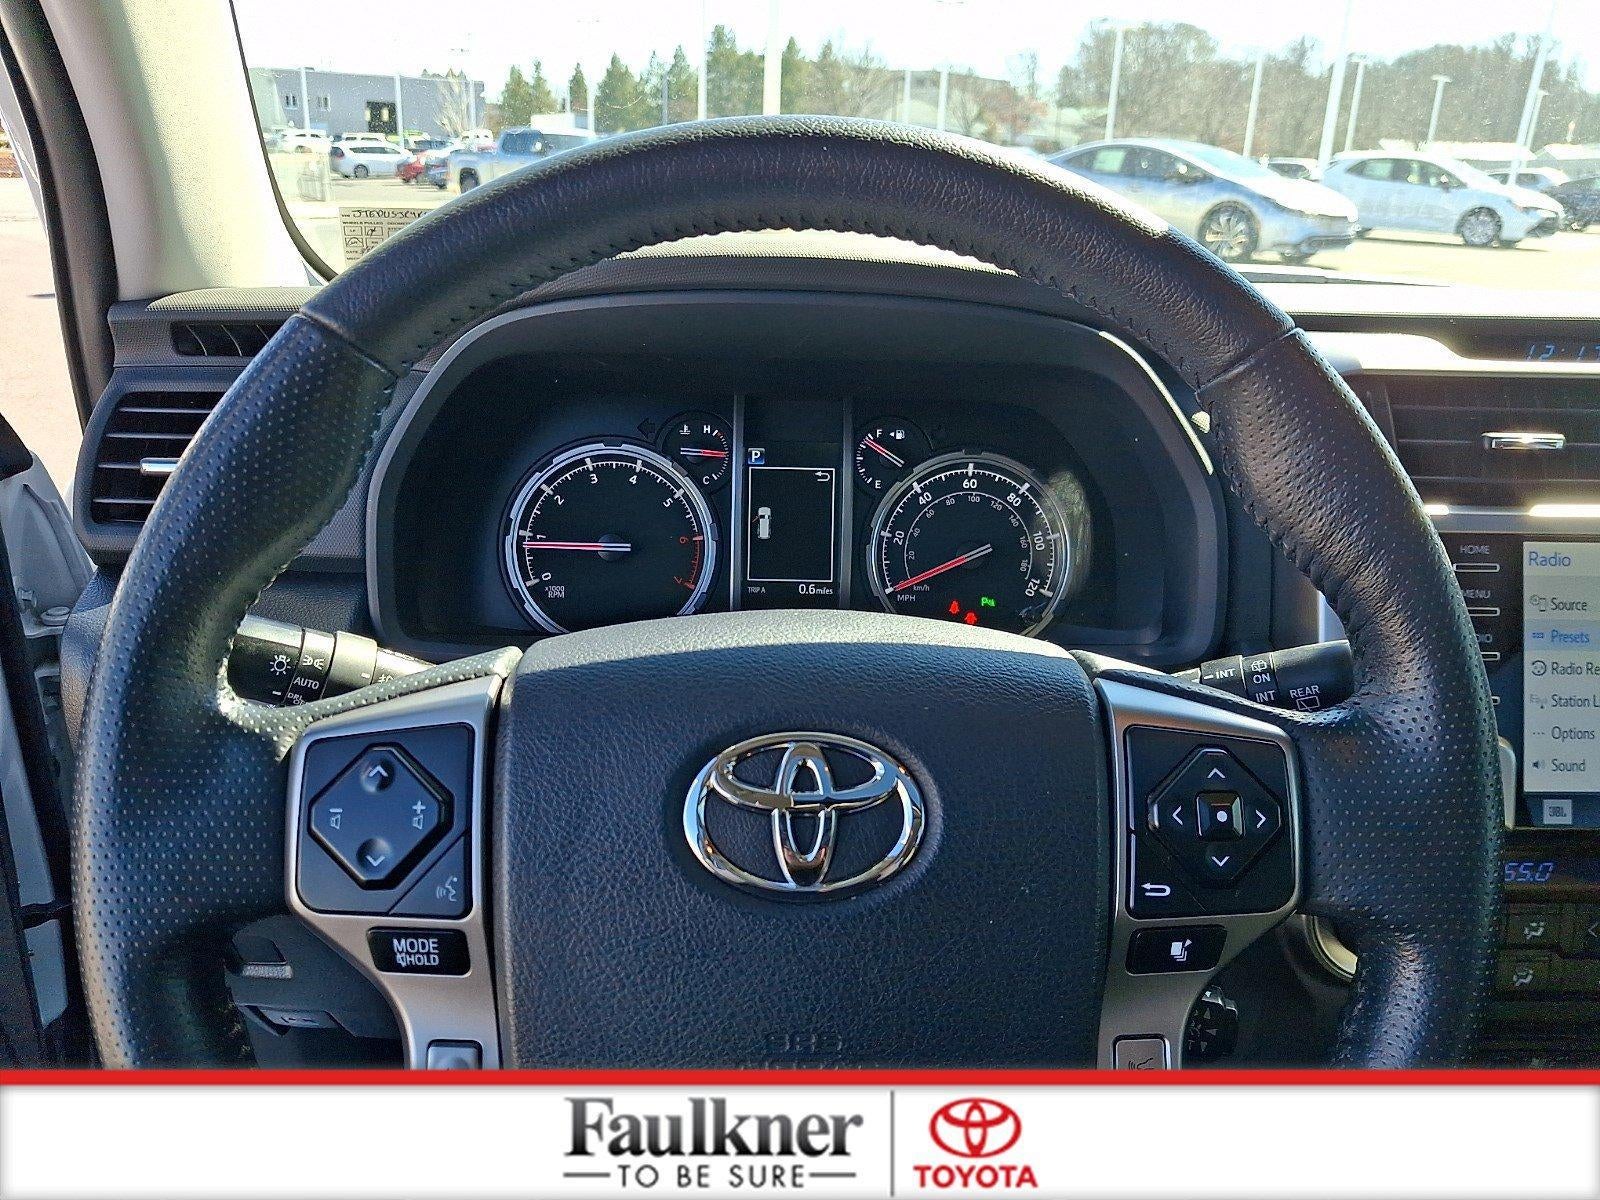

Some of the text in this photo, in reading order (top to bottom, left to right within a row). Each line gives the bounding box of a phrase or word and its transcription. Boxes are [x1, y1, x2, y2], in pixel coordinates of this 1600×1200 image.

[703, 425, 711, 434] H
[876, 429, 883, 438] F
[752, 451, 761, 462] P
[589, 474, 598, 484] 3
[629, 474, 638, 485] 4
[702, 475, 710, 485] C
[875, 480, 882, 489] E
[963, 479, 977, 489] 60
[554, 495, 565, 506] 2
[662, 497, 674, 508] 5
[918, 492, 932, 506] 40
[967, 495, 981, 503] 100
[1007, 492, 1022, 507] 80
[990, 500, 1003, 511] 120
[926, 509, 935, 518] 60
[679, 536, 689, 544] 6
[893, 531, 904, 545] 20
[1032, 530, 1045, 551] 100
[909, 550, 916, 560] 20
[1460, 545, 1490, 554] HOME
[1528, 551, 1571, 567] Radio
[542, 572, 551, 580] 0
[747, 586, 766, 594] TRIP A
[913, 584, 930, 592] km/h
[1025, 578, 1041, 597] 120
[897, 594, 916, 602] MPH
[1550, 597, 1588, 612] Source
[1551, 629, 1590, 644] Presets
[1551, 660, 1582, 675] Radio
[1216, 668, 1236, 679] INT
[1253, 672, 1271, 684] ON
[294, 676, 320, 690] AUTO
[1255, 690, 1275, 703] INT
[1289, 685, 1320, 699] REAR
[1551, 692, 1589, 708] Station
[1551, 724, 1595, 742] Options
[1551, 758, 1586, 773] Sound
[392, 938, 440, 953] MODE
[407, 954, 440, 966] HOLD
